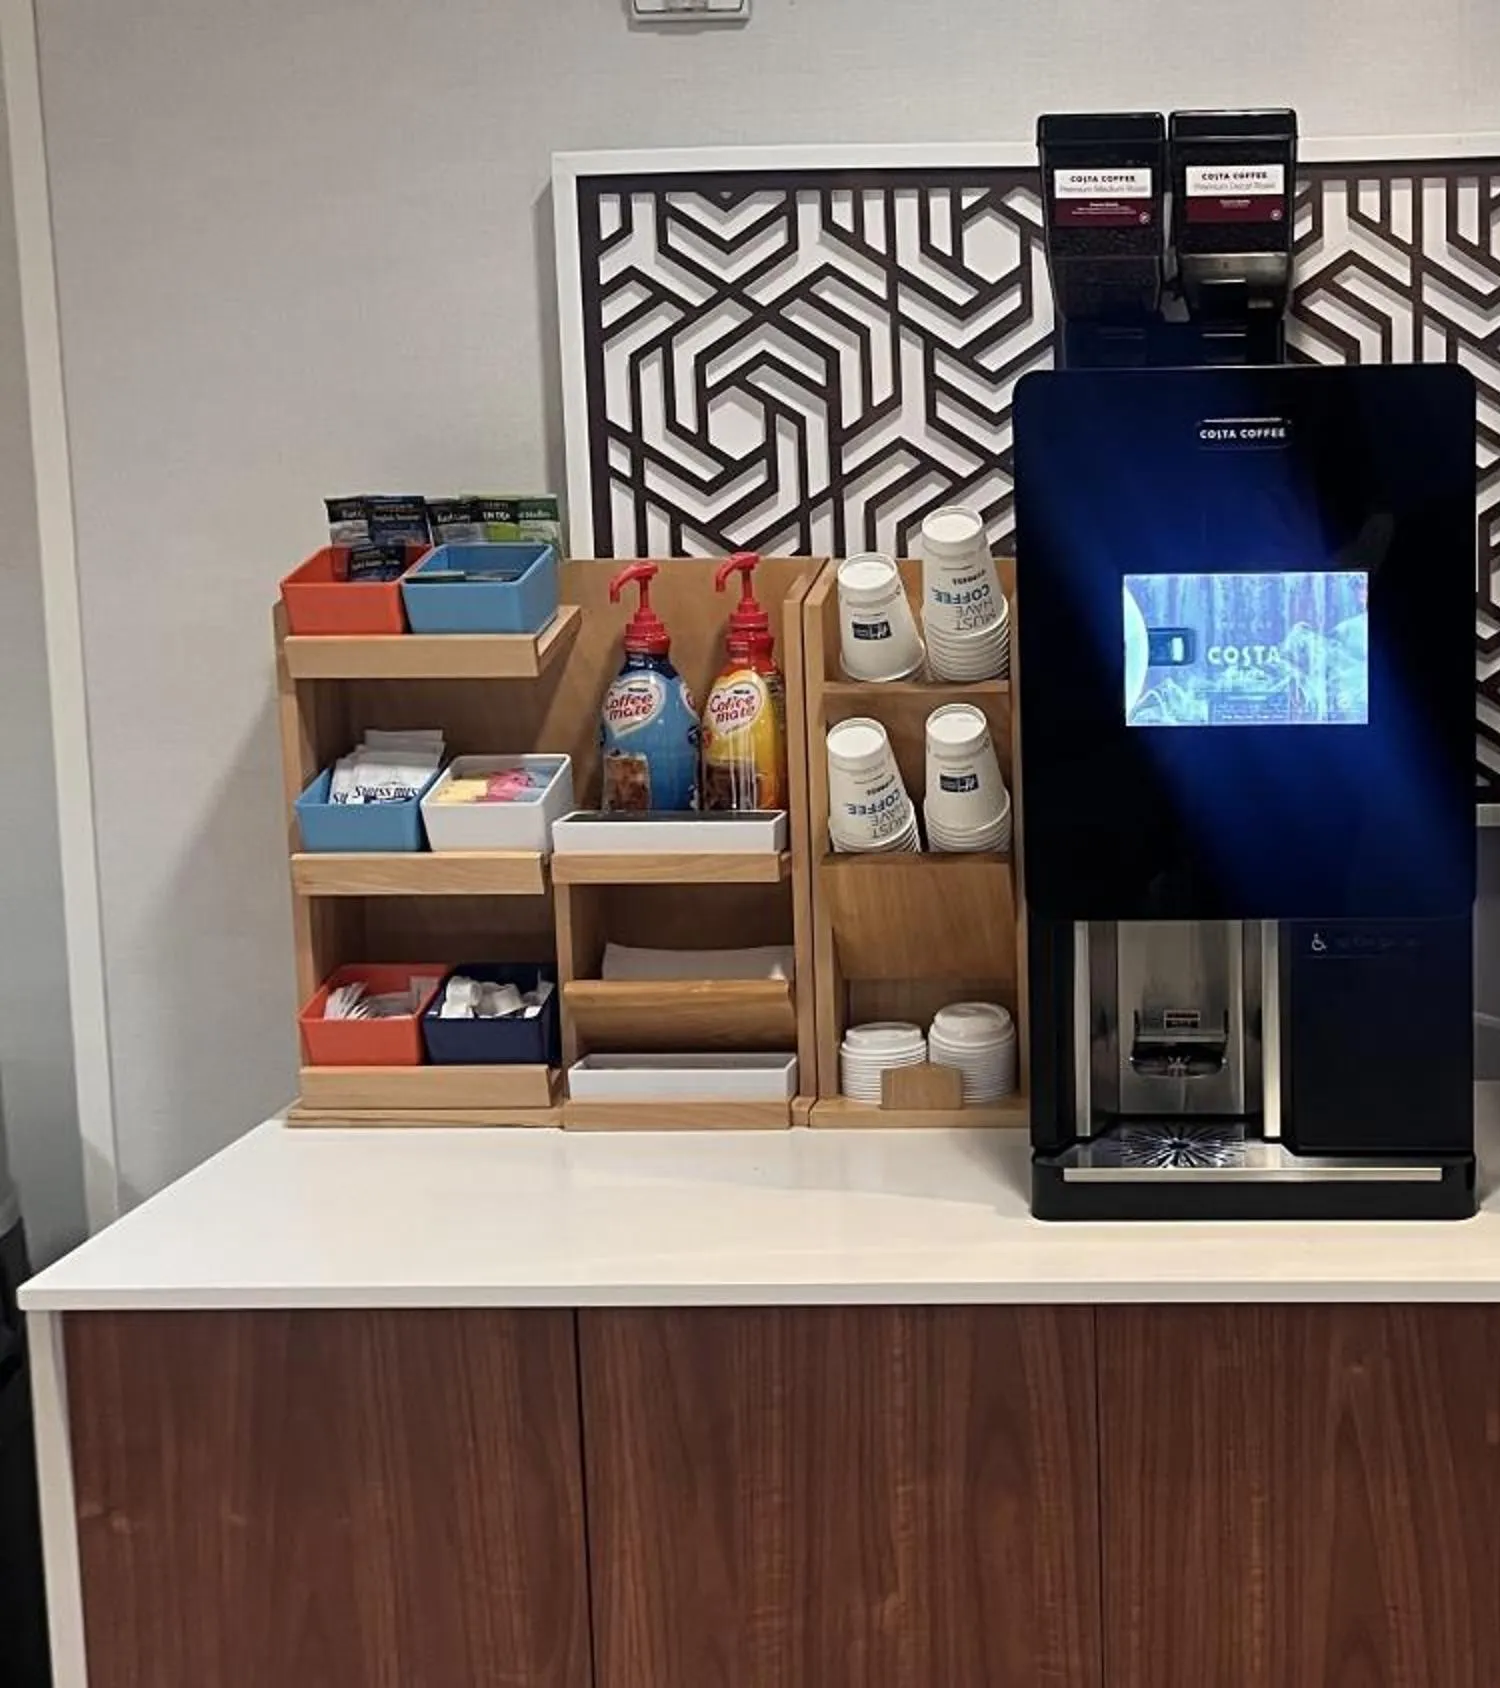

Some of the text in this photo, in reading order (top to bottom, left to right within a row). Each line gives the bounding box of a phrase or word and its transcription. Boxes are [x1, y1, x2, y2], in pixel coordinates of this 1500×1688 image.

[1070, 175, 1135, 184] COSTA COFFEE
[1201, 171, 1267, 181] COSTA COFFEE
[1199, 427, 1286, 440] COSTA COFFEE
[1207, 645, 1280, 667] COSTA
[710, 693, 755, 712] Coffee
